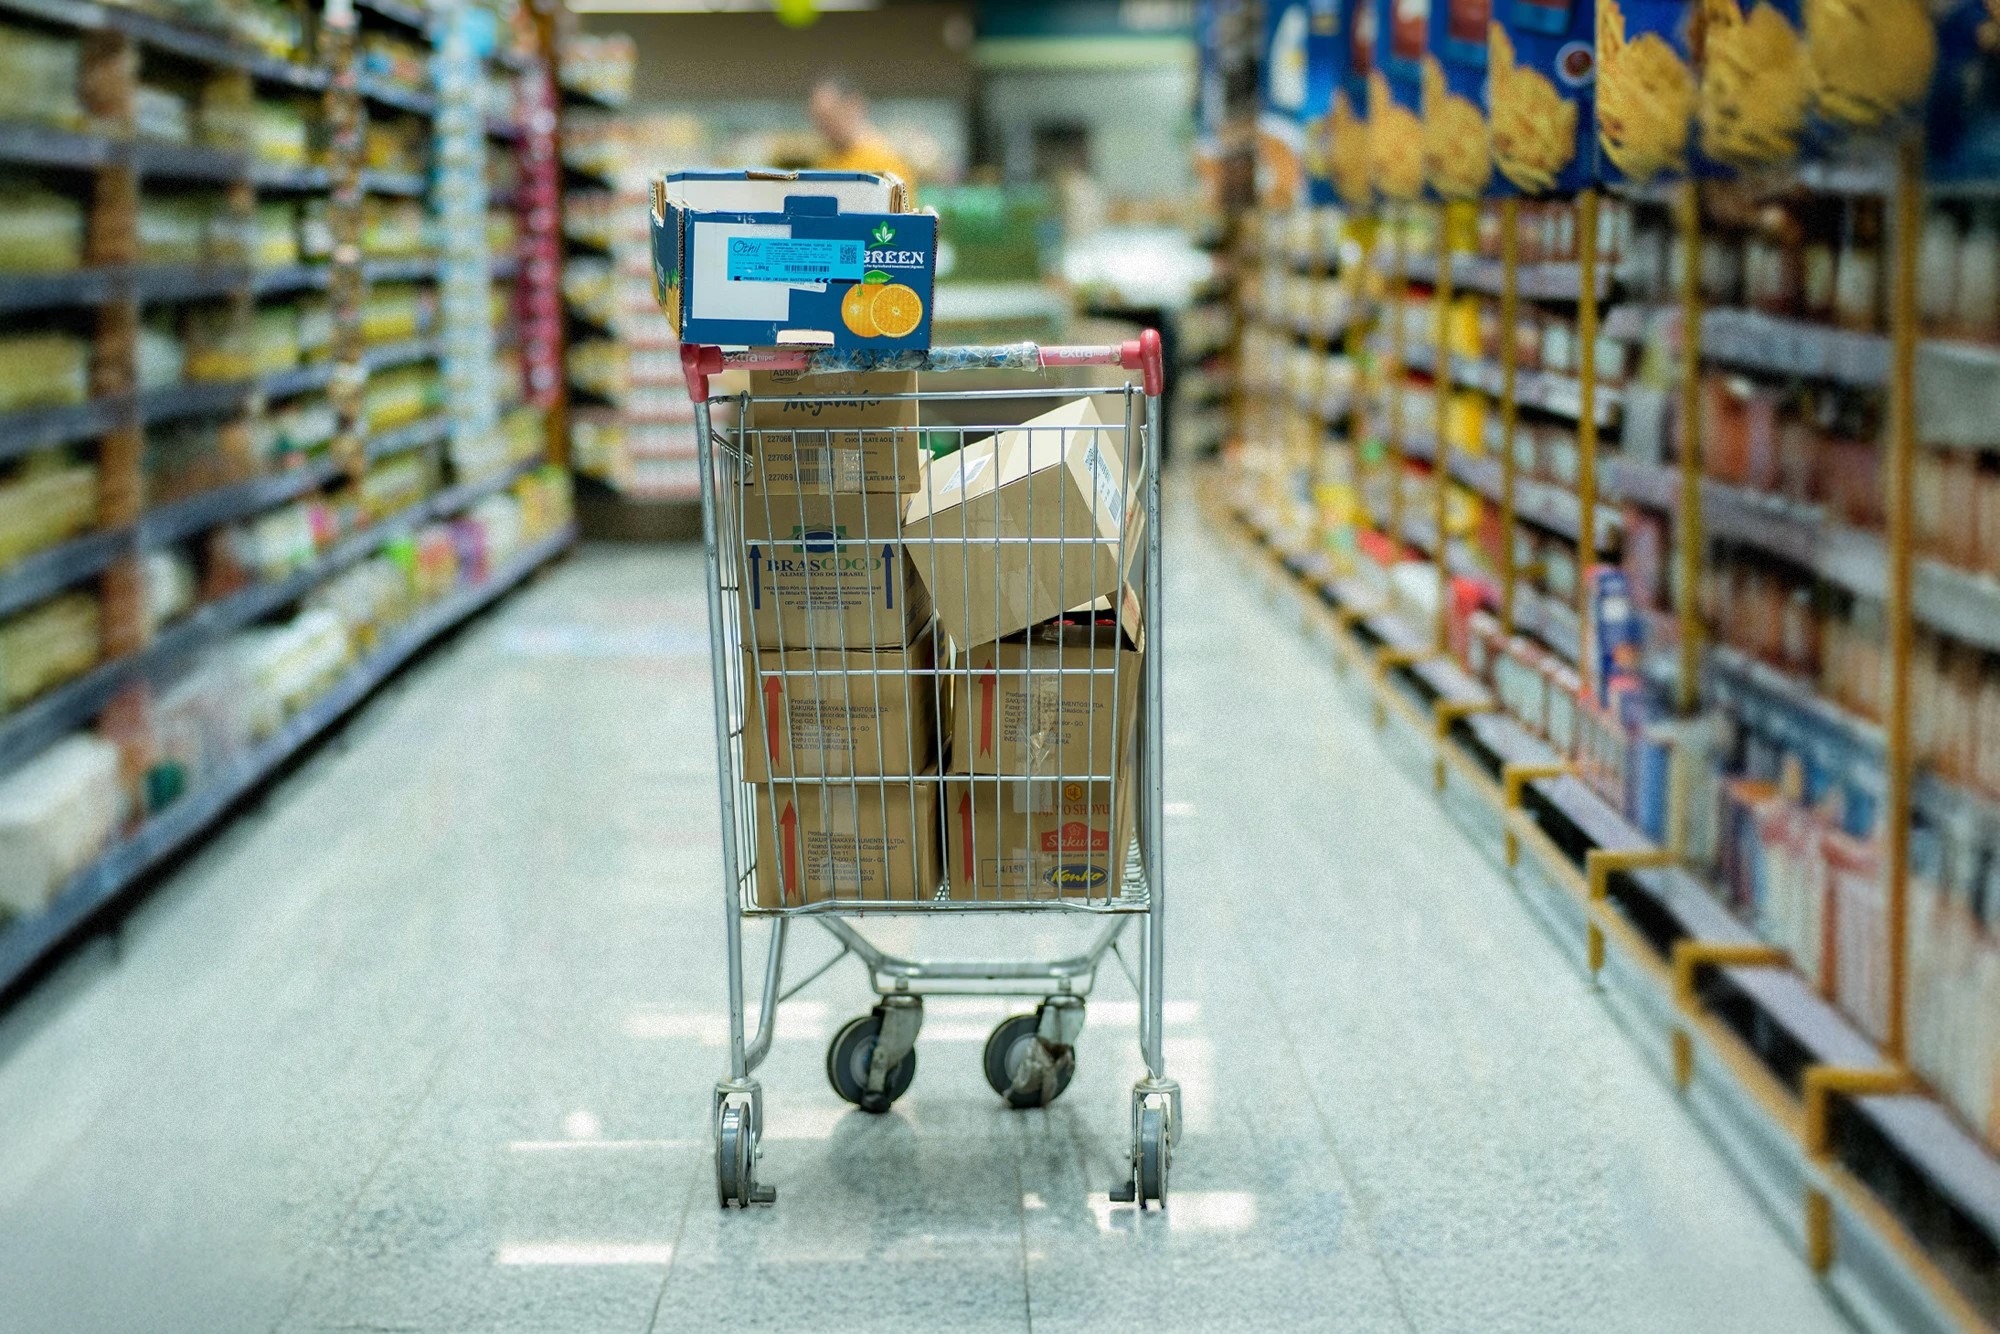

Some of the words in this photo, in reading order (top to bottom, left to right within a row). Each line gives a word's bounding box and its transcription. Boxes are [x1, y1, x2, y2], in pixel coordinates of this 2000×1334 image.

[1060, 349, 1092, 358] extra
[767, 453, 793, 462] 227068
[768, 473, 794, 481] 227069
[767, 557, 882, 572] BRASCOCO
[1050, 869, 1104, 882] Kenko
